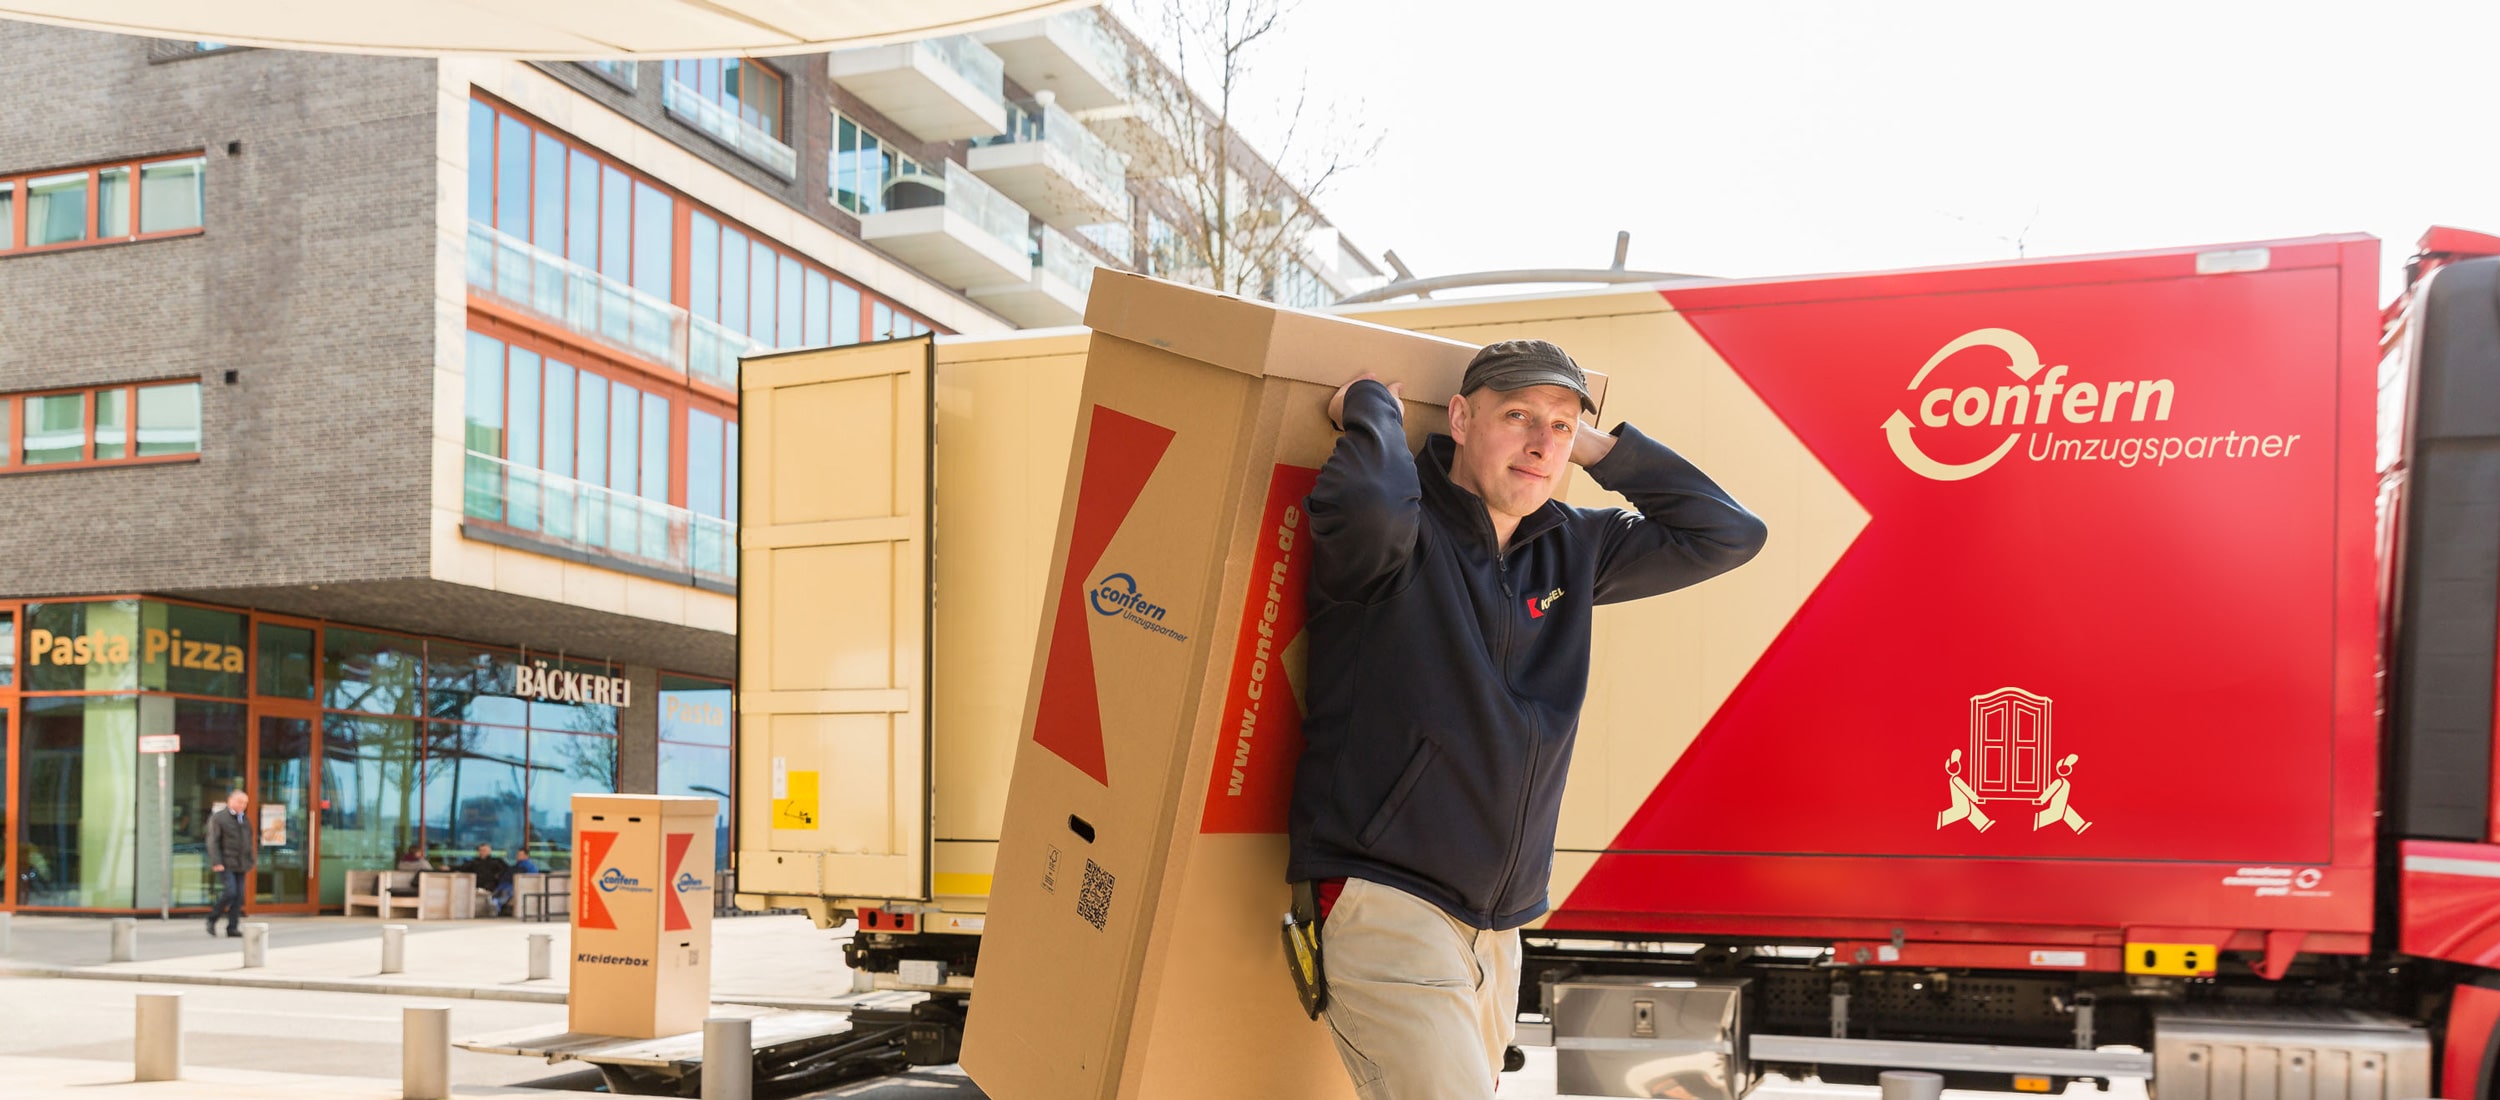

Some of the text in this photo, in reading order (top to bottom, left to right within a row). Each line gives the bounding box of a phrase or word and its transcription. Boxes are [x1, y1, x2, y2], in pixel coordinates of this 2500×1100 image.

[1919, 364, 2175, 428] confern
[2028, 430, 2300, 468] Umzugspartner
[1100, 585, 1167, 621] confern
[1122, 610, 1188, 643] Umzugspartner
[30, 628, 245, 673] Pasta Pizza
[1227, 504, 1300, 797] www.confern.de
[516, 659, 631, 708] BÄCKEREI
[666, 696, 724, 727] Pasta
[577, 953, 650, 967] Kleiderbox
